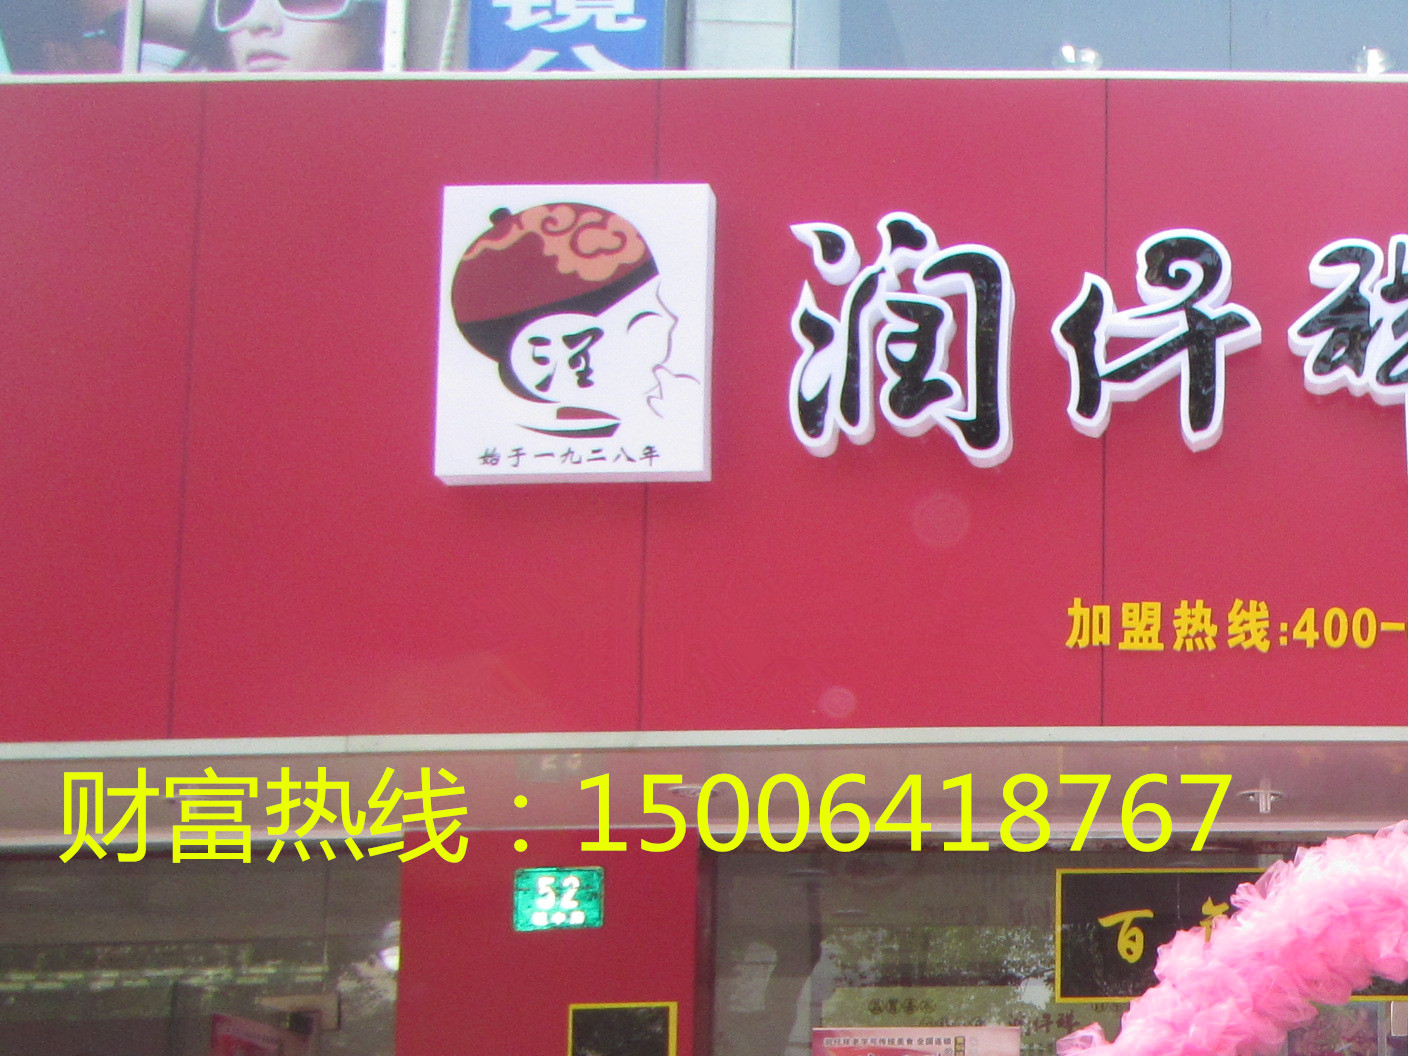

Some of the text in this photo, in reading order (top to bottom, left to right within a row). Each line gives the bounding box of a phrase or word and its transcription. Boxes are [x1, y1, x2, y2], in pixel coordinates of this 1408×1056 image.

[478, 444, 661, 467] 始于一九二八年
[535, 875, 581, 910] 52
